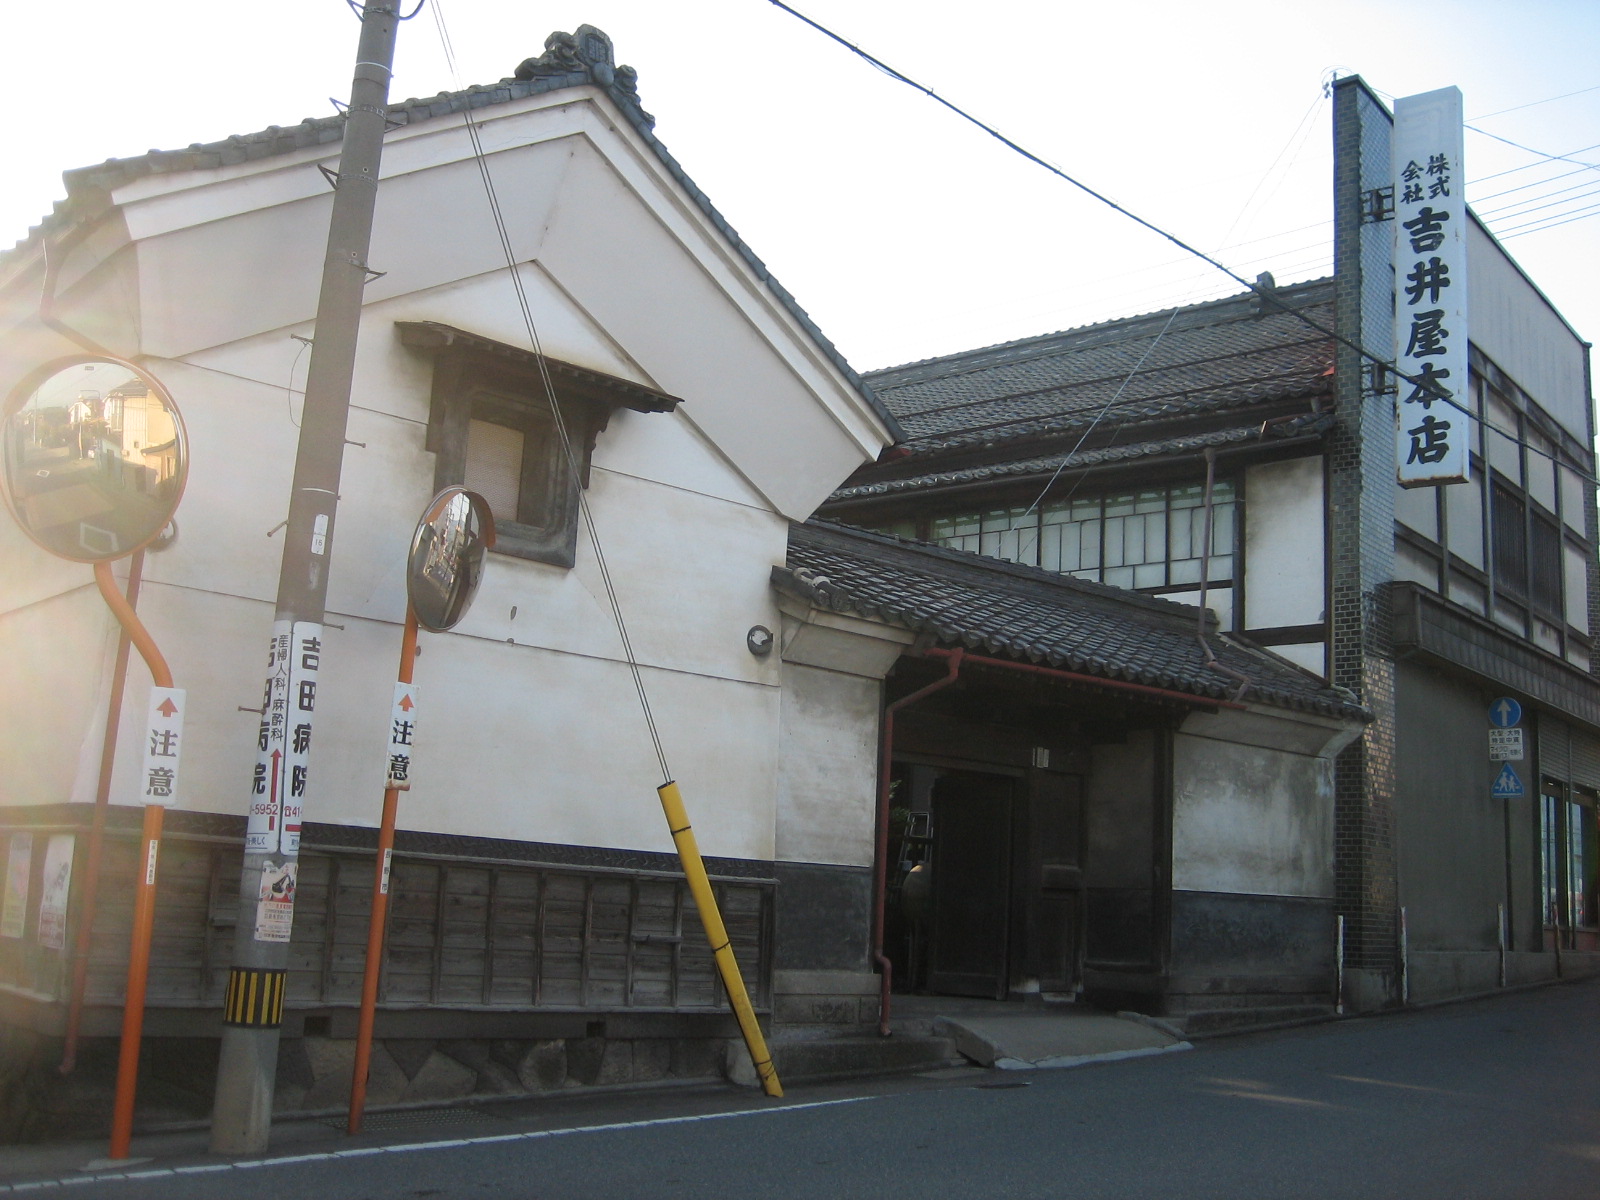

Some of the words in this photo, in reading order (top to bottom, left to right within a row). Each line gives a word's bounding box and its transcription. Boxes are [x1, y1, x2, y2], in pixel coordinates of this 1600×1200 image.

[1400, 160, 1425, 204] 会社
[1425, 152, 1451, 199] 株式
[1402, 206, 1453, 465] 吉井屋本店
[291, 636, 321, 797] 吉田病院
[146, 729, 178, 797] 注意
[388, 719, 414, 781] 注意
